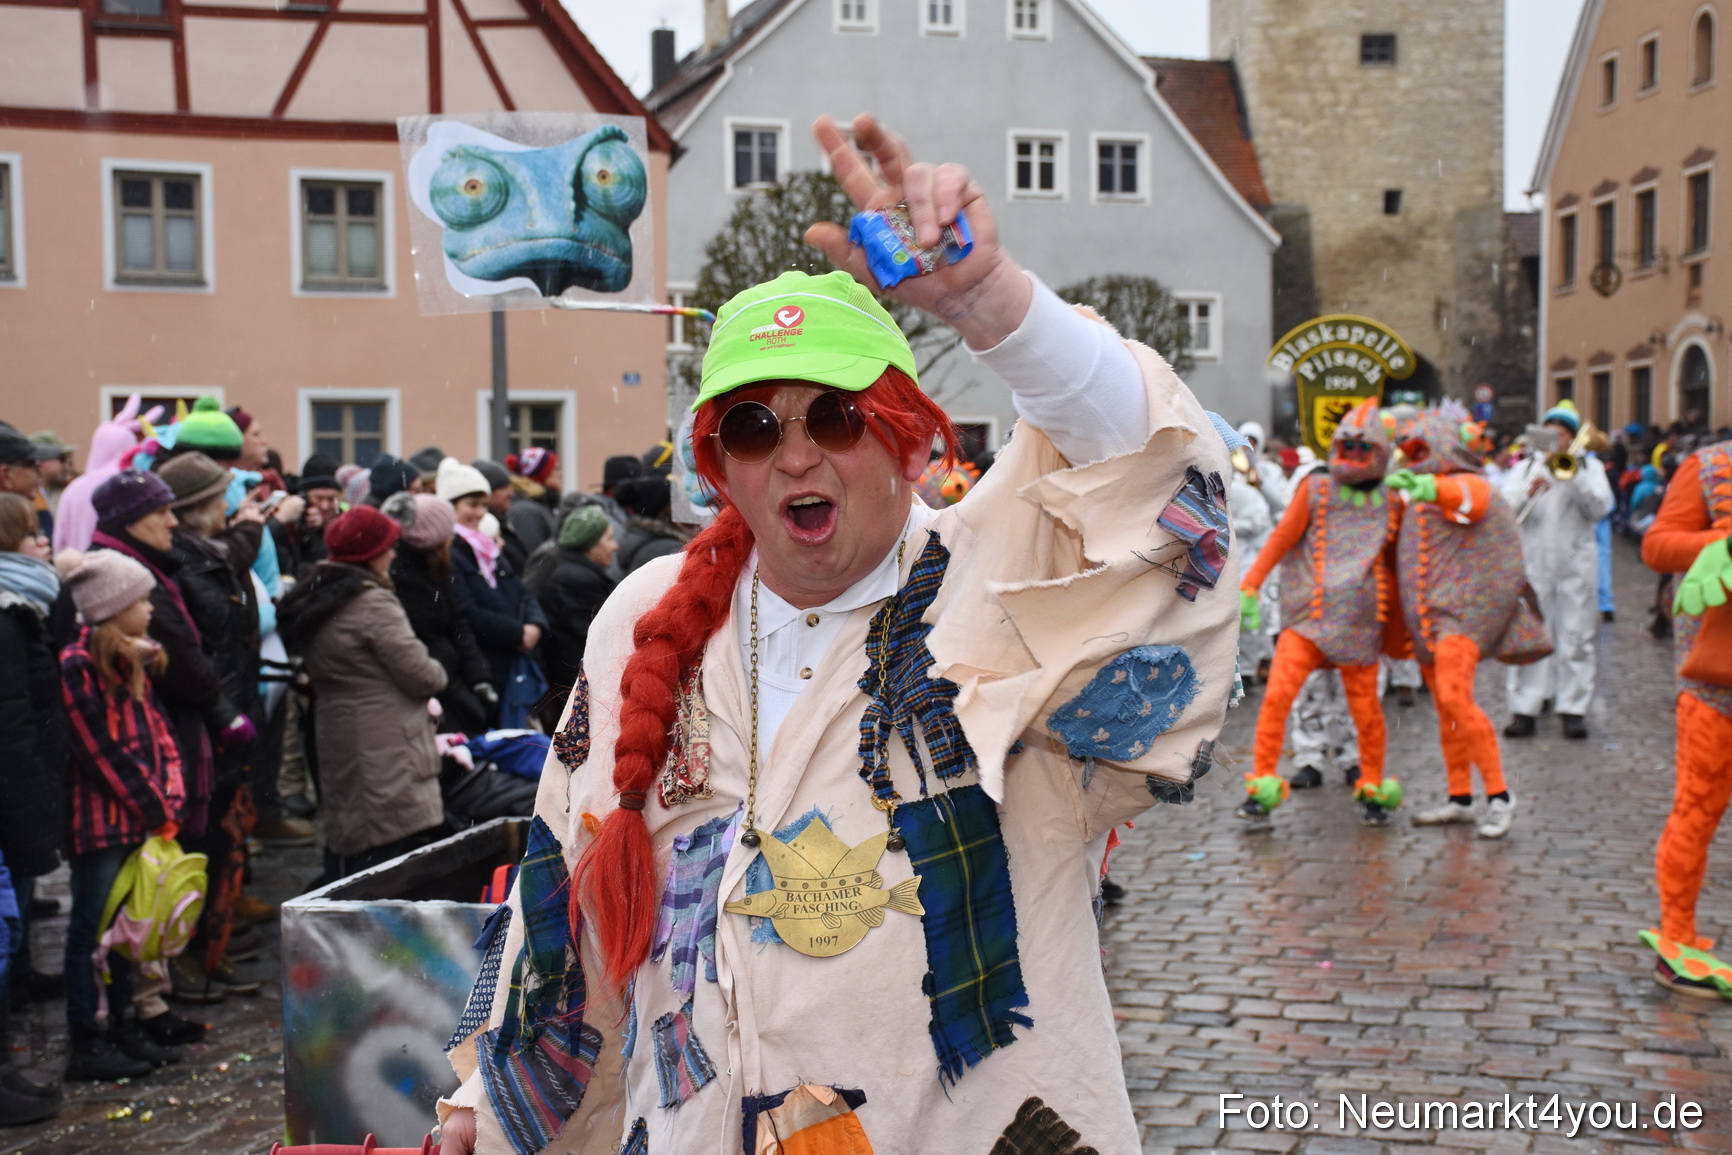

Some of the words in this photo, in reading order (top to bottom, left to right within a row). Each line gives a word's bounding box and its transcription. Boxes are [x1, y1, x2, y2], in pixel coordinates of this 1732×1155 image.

[749, 328, 803, 342] CHALLENGE
[766, 337, 787, 346] ROTH
[1272, 323, 1406, 373] Blaskapelle
[1298, 350, 1383, 385] Pilsach
[786, 887, 862, 903] BACHAMER
[793, 901, 859, 914] FASCHING
[808, 935, 839, 949] 1997
